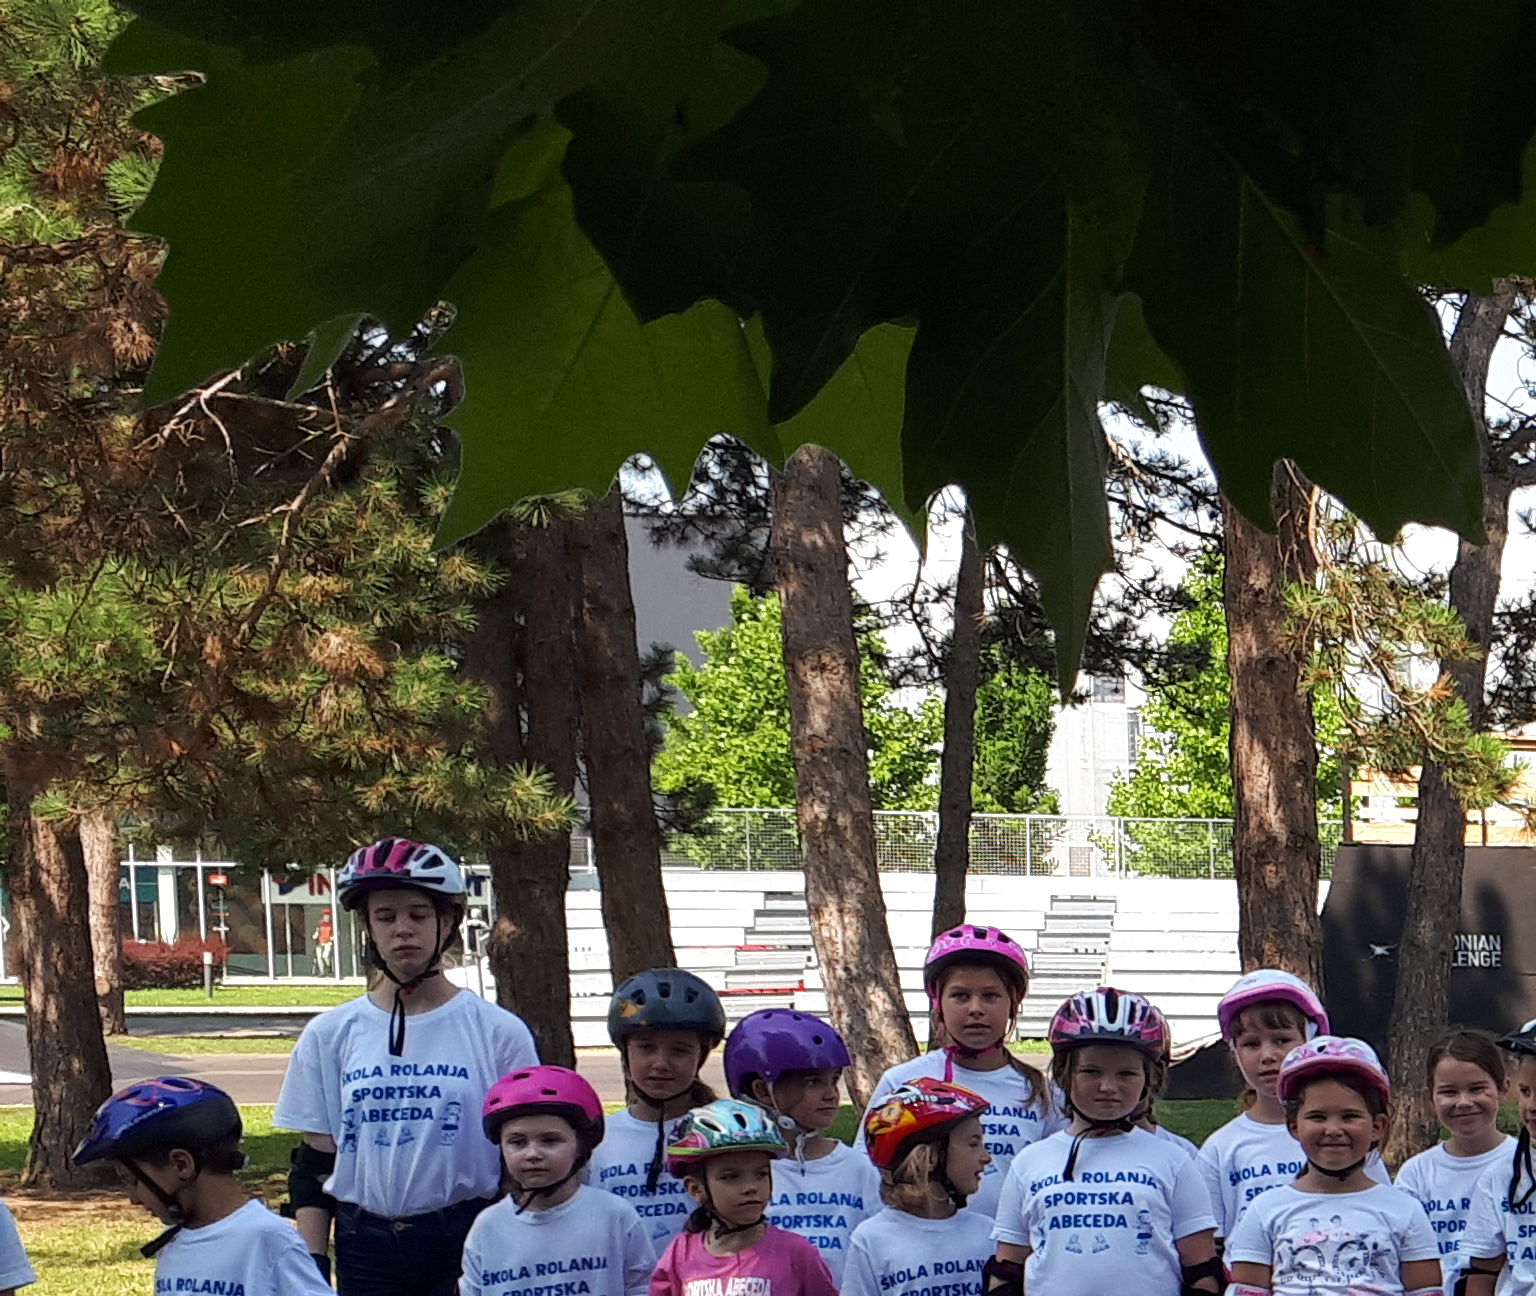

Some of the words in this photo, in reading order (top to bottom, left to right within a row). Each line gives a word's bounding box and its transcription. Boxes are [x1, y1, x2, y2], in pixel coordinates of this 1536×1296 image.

[390, 1064, 469, 1079] ROLANJA
[352, 1085, 441, 1102] SPORTSKA
[362, 1107, 434, 1123] ABECEDA
[984, 1106, 1038, 1122] OLANJA
[982, 1124, 1020, 1137] TSKA
[1082, 1171, 1158, 1189] ROLANJA
[1044, 1191, 1134, 1208] SPORTSKA
[635, 1202, 688, 1217] ECEDA
[765, 1215, 847, 1229] PORTSKA
[1049, 1214, 1128, 1230] ABECEDA
[482, 1266, 531, 1286] ŠKOLA
[881, 1265, 928, 1290] ŠKOLA
[934, 1260, 985, 1276] ROLAN
